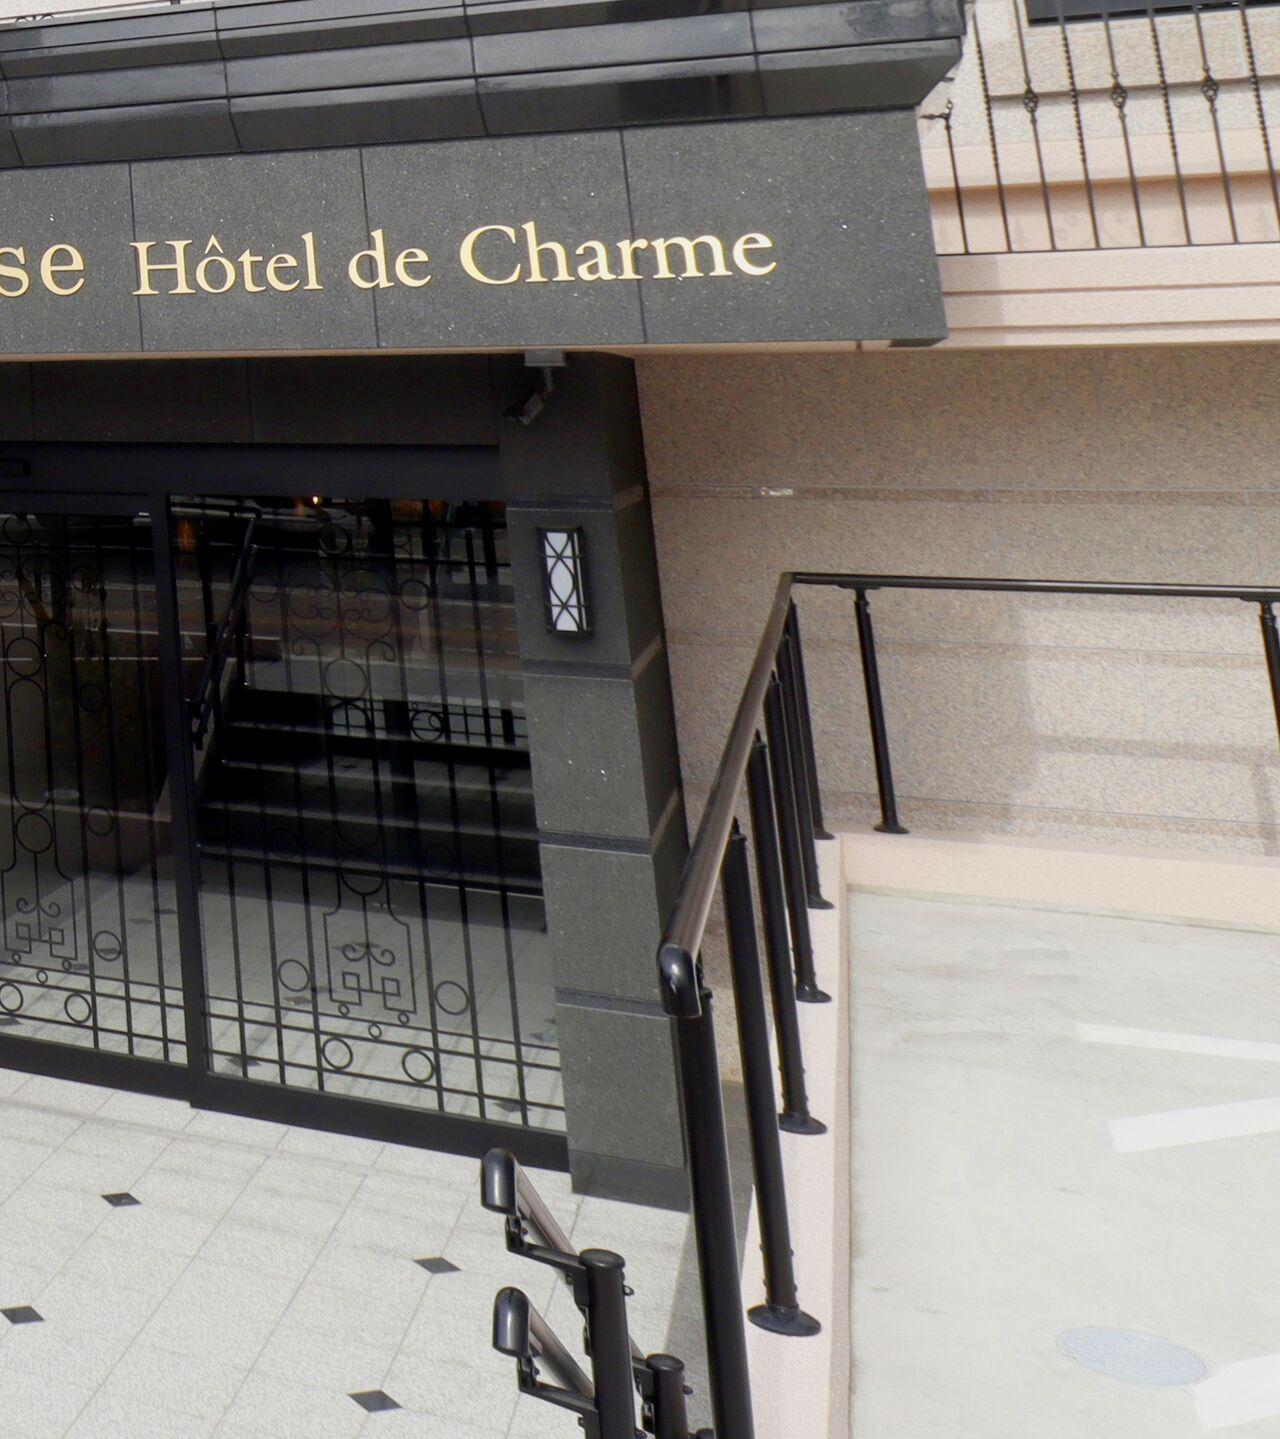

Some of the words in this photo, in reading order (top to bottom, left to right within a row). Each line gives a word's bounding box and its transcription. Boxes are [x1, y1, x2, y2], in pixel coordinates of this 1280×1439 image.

[131, 232, 323, 296] Hôtel
[348, 229, 433, 289] de
[460, 222, 778, 285] Charme
